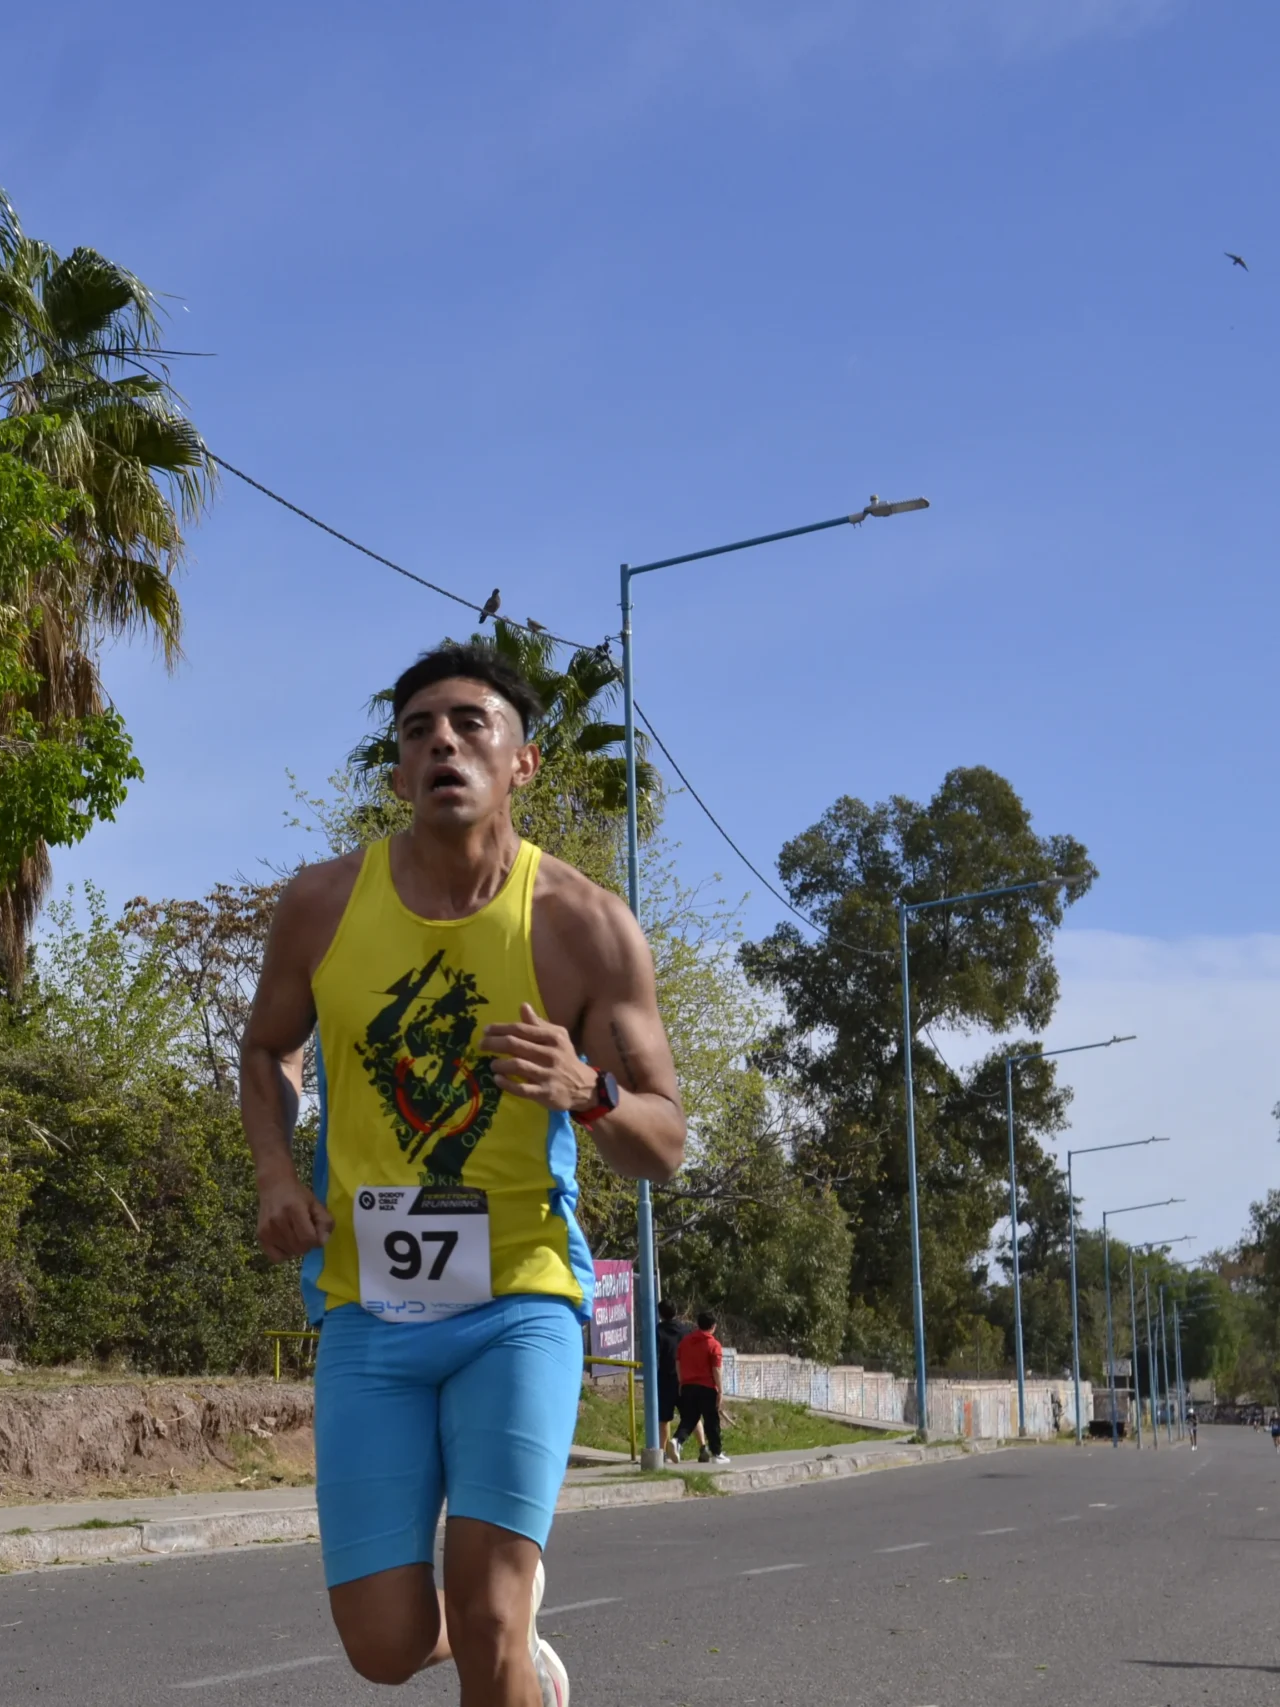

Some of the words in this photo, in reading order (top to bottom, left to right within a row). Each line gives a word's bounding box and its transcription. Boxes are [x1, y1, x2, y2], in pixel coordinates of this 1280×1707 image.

[421, 1199, 479, 1208] RUNNING
[383, 1230, 458, 1280] 97
[366, 1300, 426, 1314] BYD
